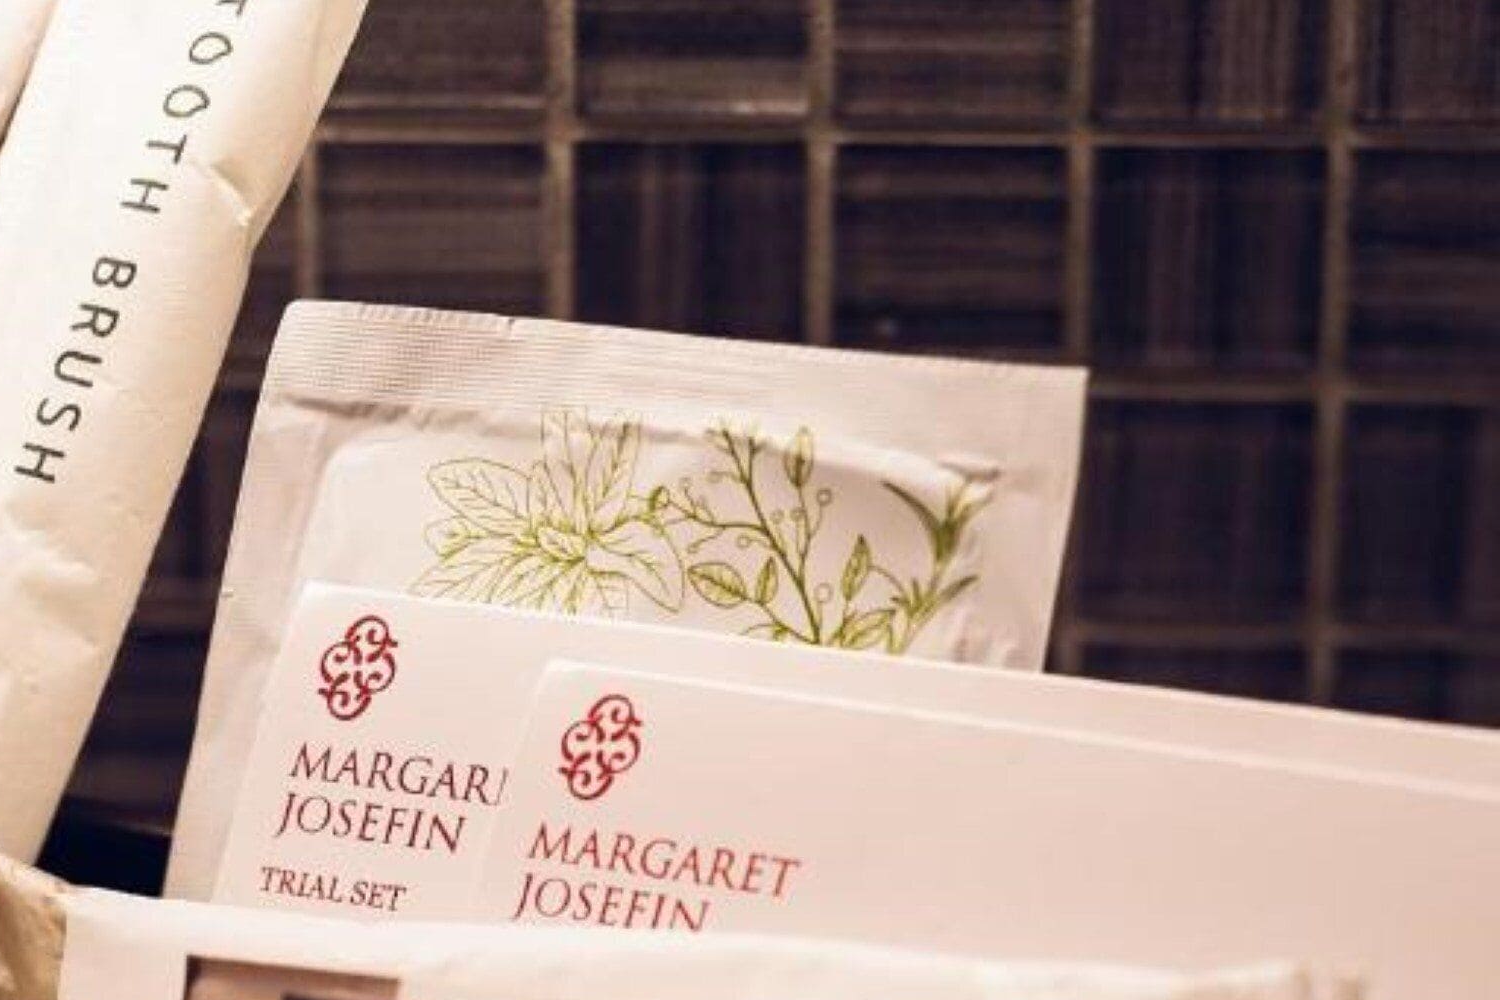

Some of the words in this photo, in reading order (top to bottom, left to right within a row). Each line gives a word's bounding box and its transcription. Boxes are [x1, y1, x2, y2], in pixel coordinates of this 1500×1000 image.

[14, 254, 138, 485] BRUSH
[275, 793, 466, 853] JOSEFIN
[260, 866, 342, 903] TRIAL
[349, 880, 407, 911] SET
[528, 821, 802, 898] MARGARET
[511, 872, 712, 932] JOSEFIN
